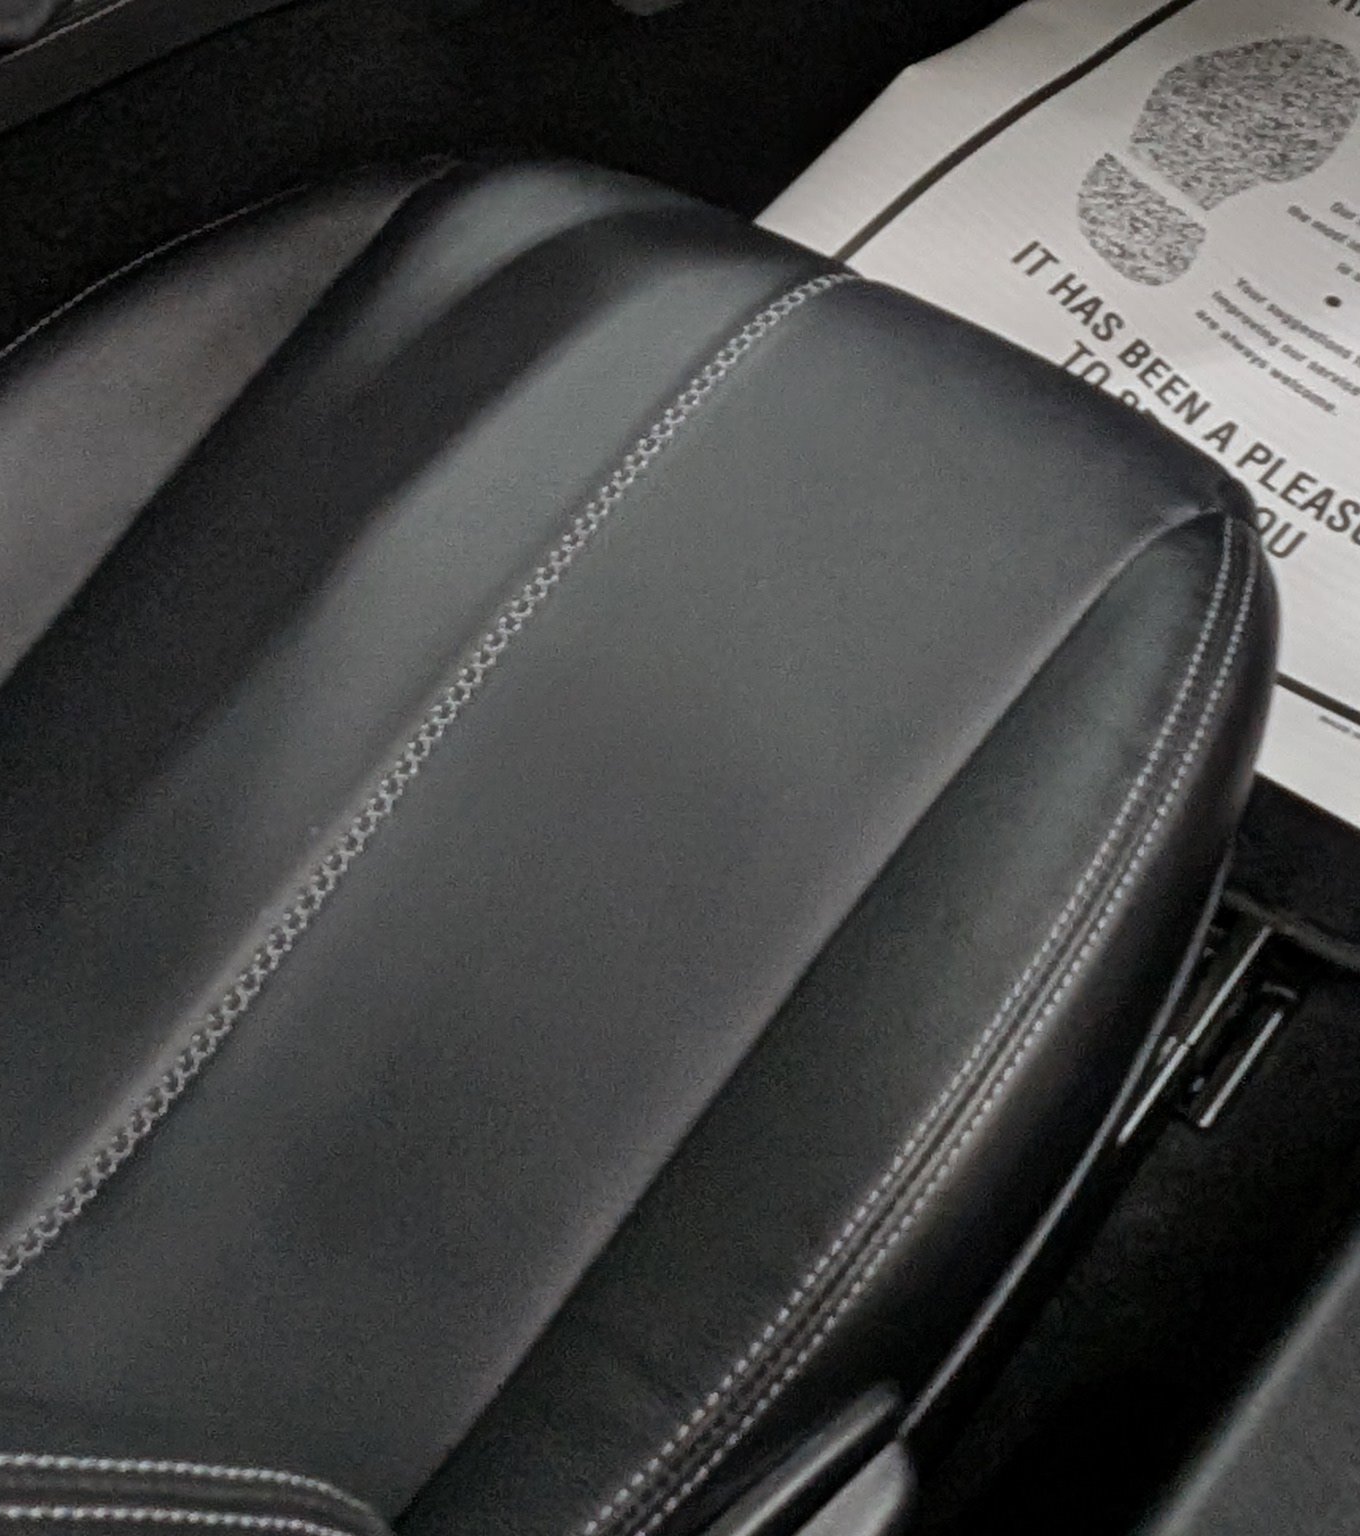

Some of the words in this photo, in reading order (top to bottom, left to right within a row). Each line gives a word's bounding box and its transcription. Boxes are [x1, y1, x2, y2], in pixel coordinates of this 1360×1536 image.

[1010, 240, 1061, 277] IT
[1048, 272, 1125, 342] HAS
[1117, 338, 1213, 425] BEEN
[1203, 420, 1239, 453] A
[1062, 339, 1111, 386] TO
[1256, 507, 1307, 558] OU
